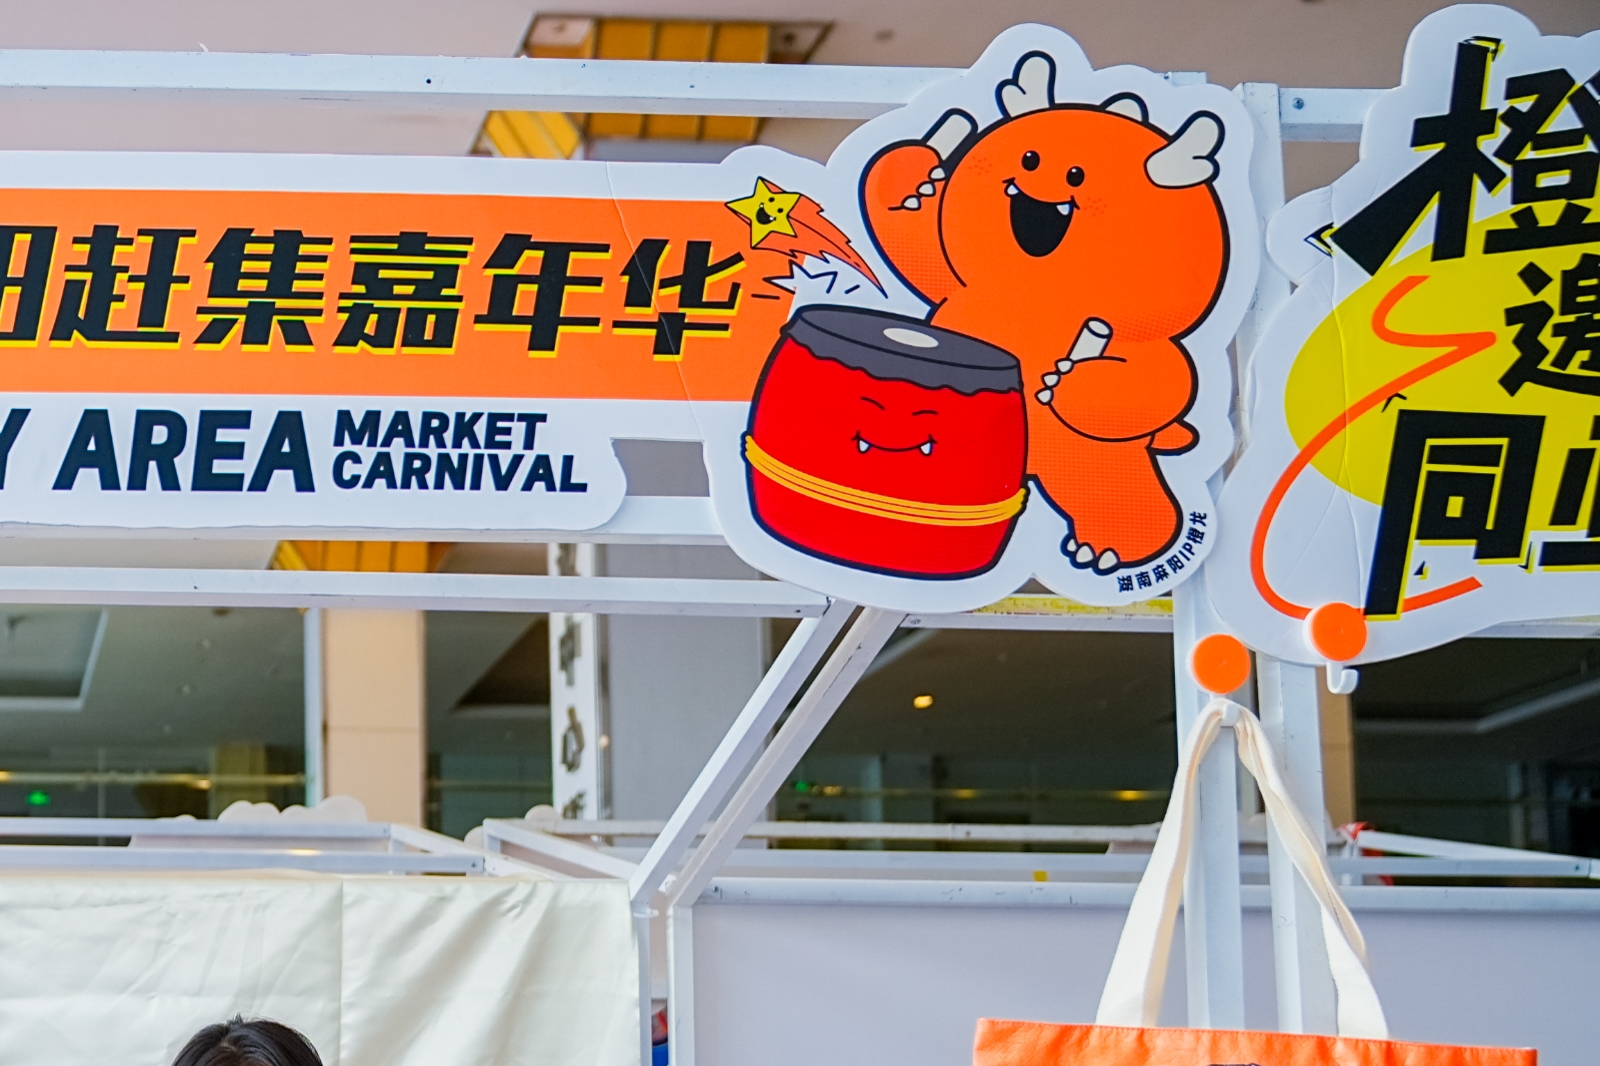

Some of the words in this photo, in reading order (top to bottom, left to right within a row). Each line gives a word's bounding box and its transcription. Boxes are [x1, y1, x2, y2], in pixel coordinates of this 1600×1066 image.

[52, 408, 316, 494] AREA
[332, 409, 548, 451] MARKET
[331, 450, 589, 494] CARNIVAL
[1116, 511, 1208, 593] 湖南麻阳IP橙龙
